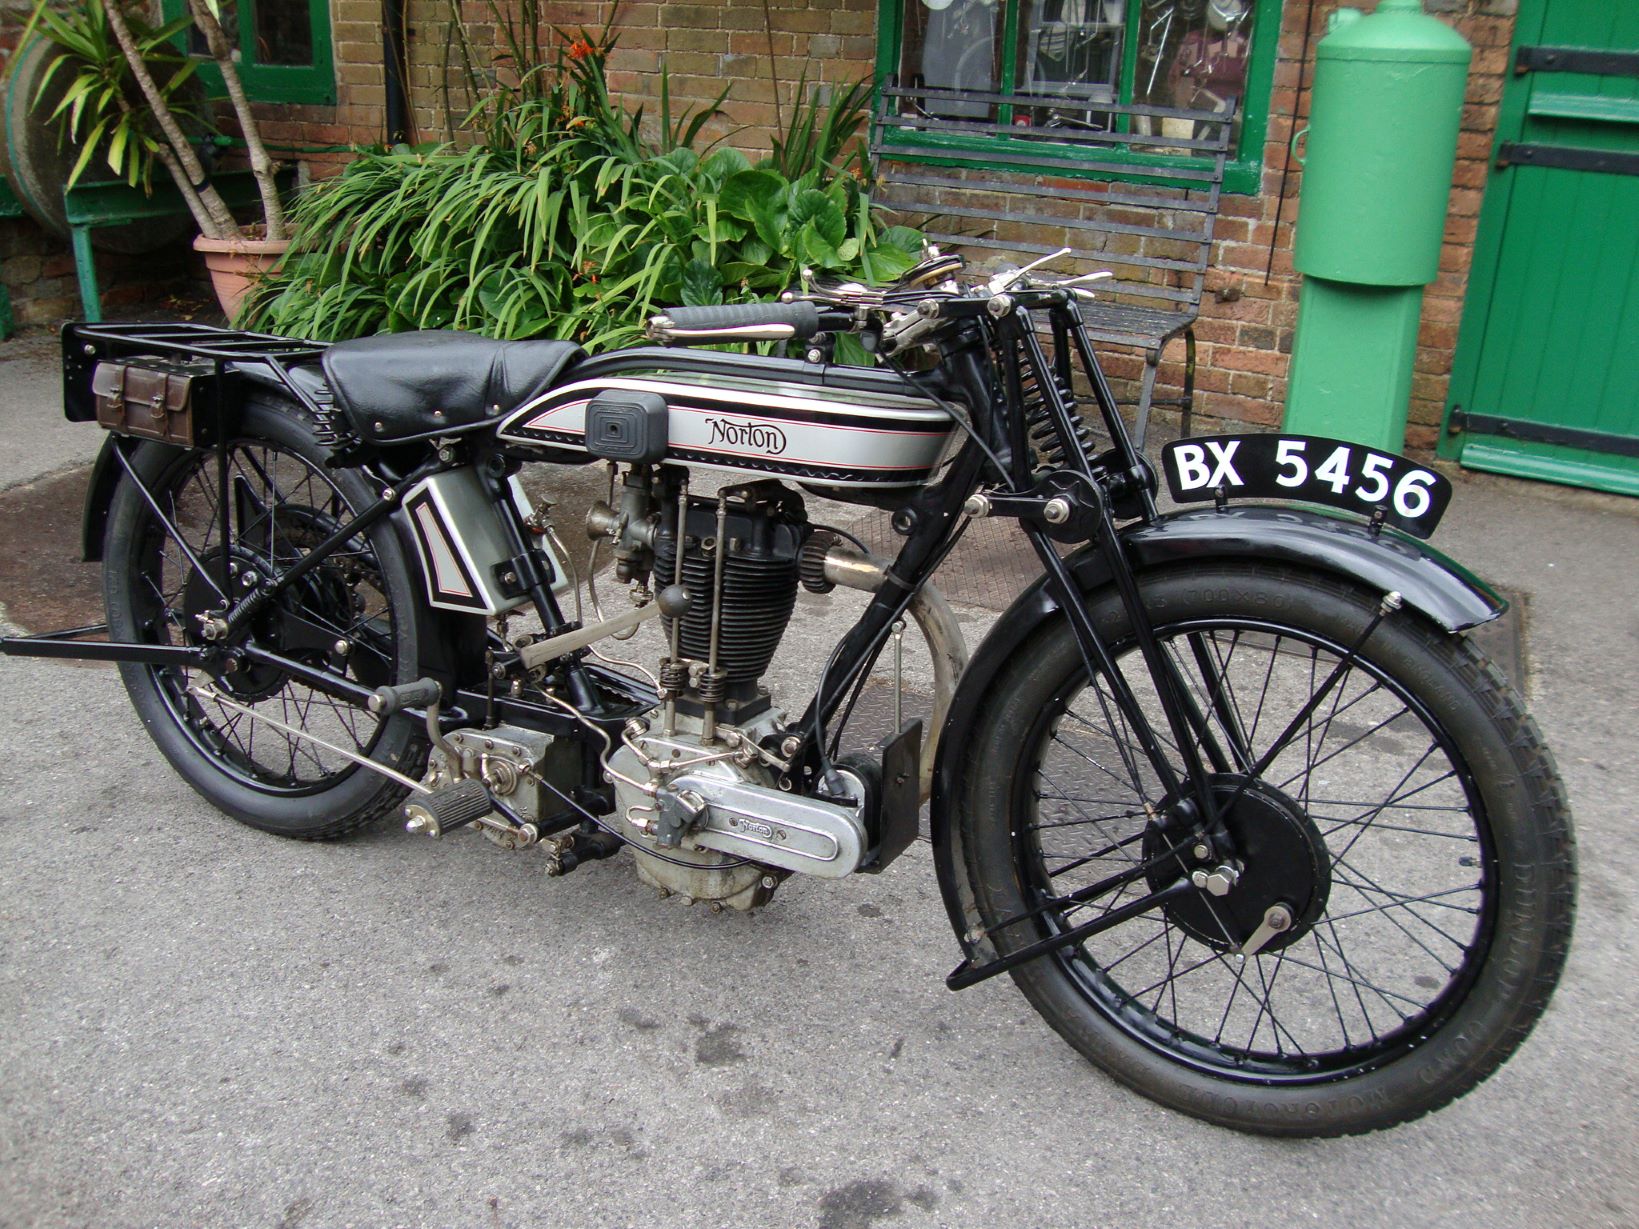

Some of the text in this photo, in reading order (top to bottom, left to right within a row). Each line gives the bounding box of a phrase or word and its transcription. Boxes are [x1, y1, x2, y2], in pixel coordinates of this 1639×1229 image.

[705, 418, 786, 455] Norton
[1173, 440, 1436, 518] BX 5456
[739, 819, 772, 838] Norton
[1498, 863, 1537, 1001] DUNLOP
[1175, 1082, 1393, 1120] MOTORCYCLE
